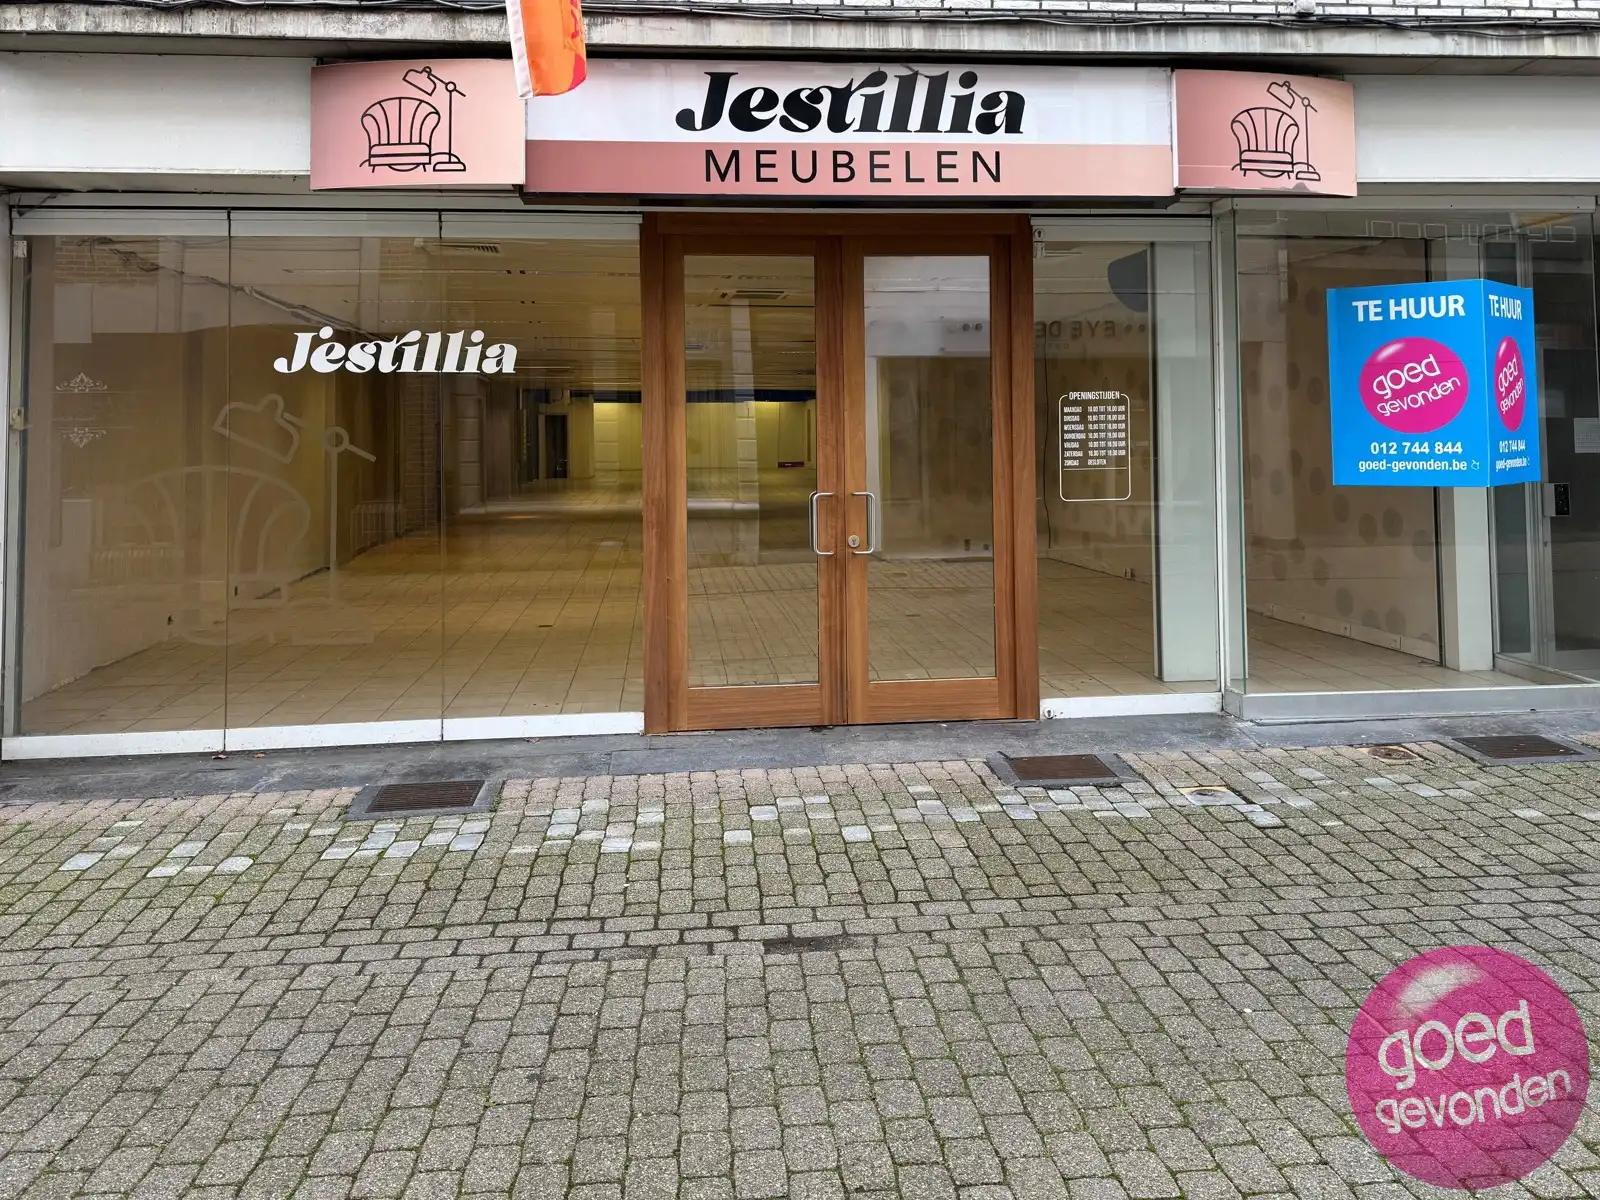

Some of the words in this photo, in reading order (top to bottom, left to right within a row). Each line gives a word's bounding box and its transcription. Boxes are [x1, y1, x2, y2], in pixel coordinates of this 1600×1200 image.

[675, 69, 1026, 135] Jestillia
[705, 149, 1001, 183] MEUBELEN
[1352, 299, 1383, 322] TE
[1389, 294, 1466, 321] HUUR
[1488, 294, 1500, 317] TE
[1500, 296, 1523, 321] HUUR
[1372, 353, 1441, 399] goed
[1498, 353, 1519, 396] goed
[1068, 391, 1120, 400] OPENINGSTIJDEN
[1376, 375, 1461, 417] gevonden
[1499, 377, 1524, 415] gevonden
[1370, 442, 1397, 455] 012
[1402, 442, 1430, 455] 744
[1434, 442, 1463, 455] 844
[1499, 440, 1509, 453] 012
[1509, 440, 1518, 453] 744
[1518, 439, 1526, 451] 844
[1358, 459, 1468, 472] goed-gevonden.be
